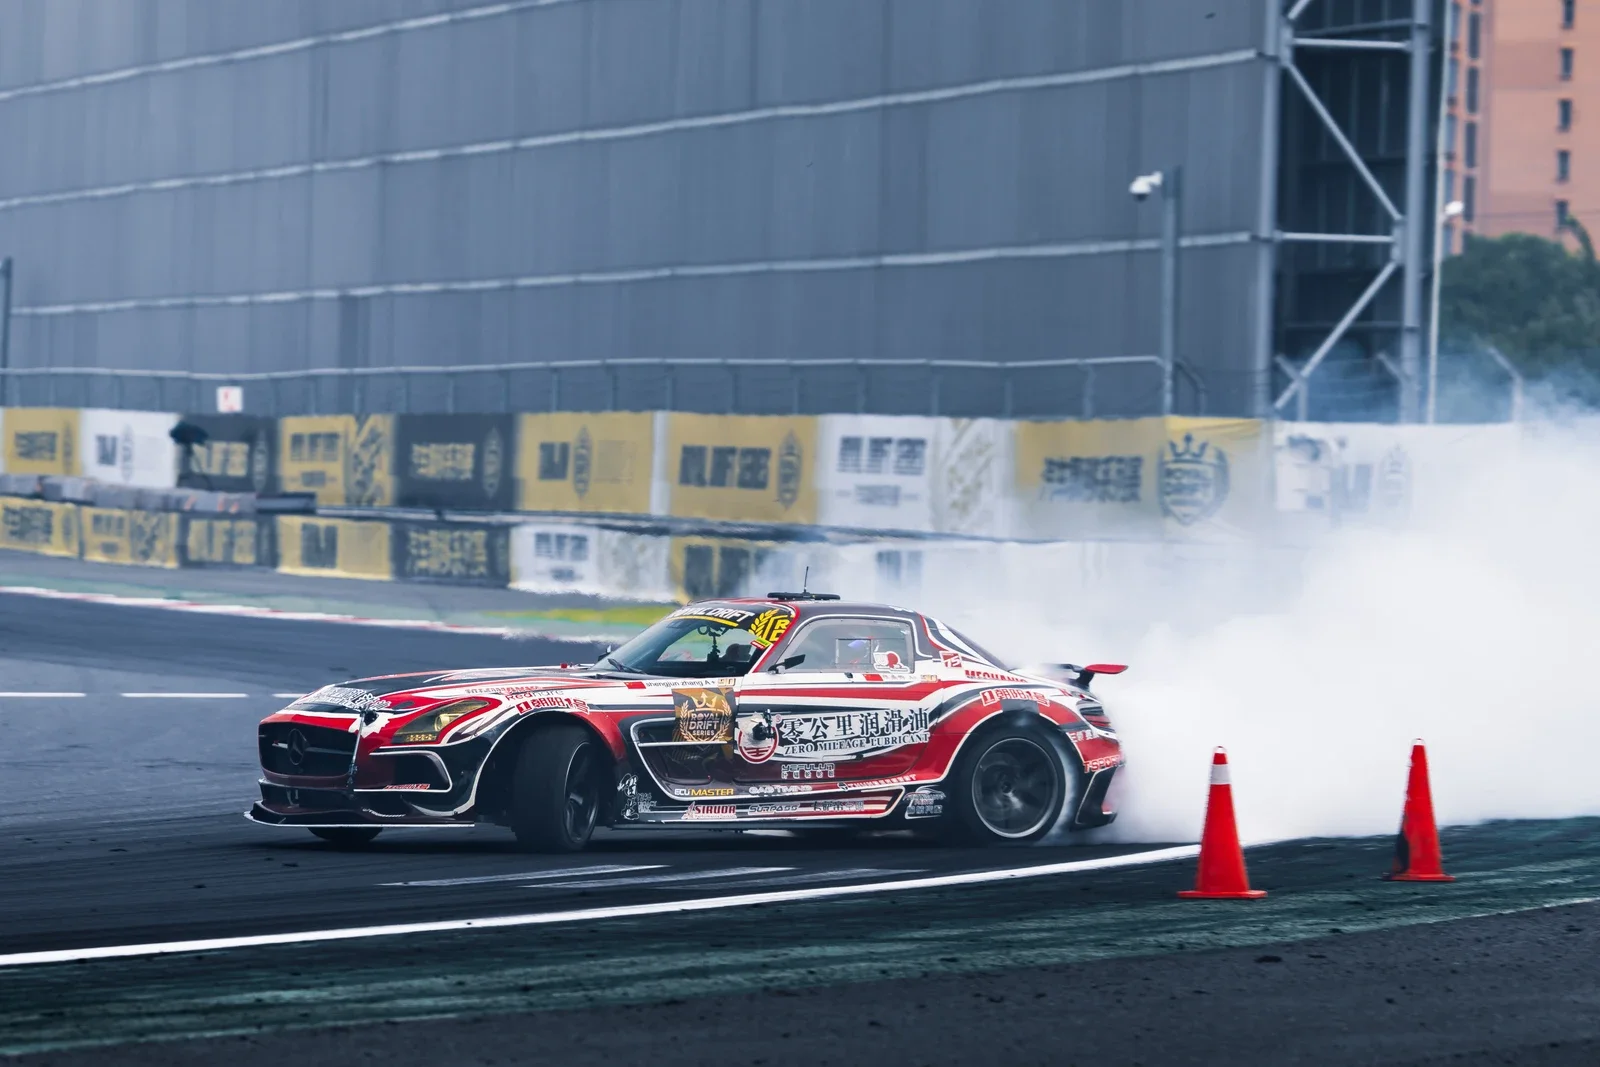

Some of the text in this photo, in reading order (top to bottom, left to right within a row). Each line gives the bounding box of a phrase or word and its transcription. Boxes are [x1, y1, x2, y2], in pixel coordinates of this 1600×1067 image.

[705, 607, 755, 622] DRIFT
[691, 713, 721, 721] ROYAL
[688, 720, 719, 730] DRIFT
[783, 707, 930, 743] 零公里润滑油
[784, 732, 930, 755] ZERO MILEAGE LUBRICANT
